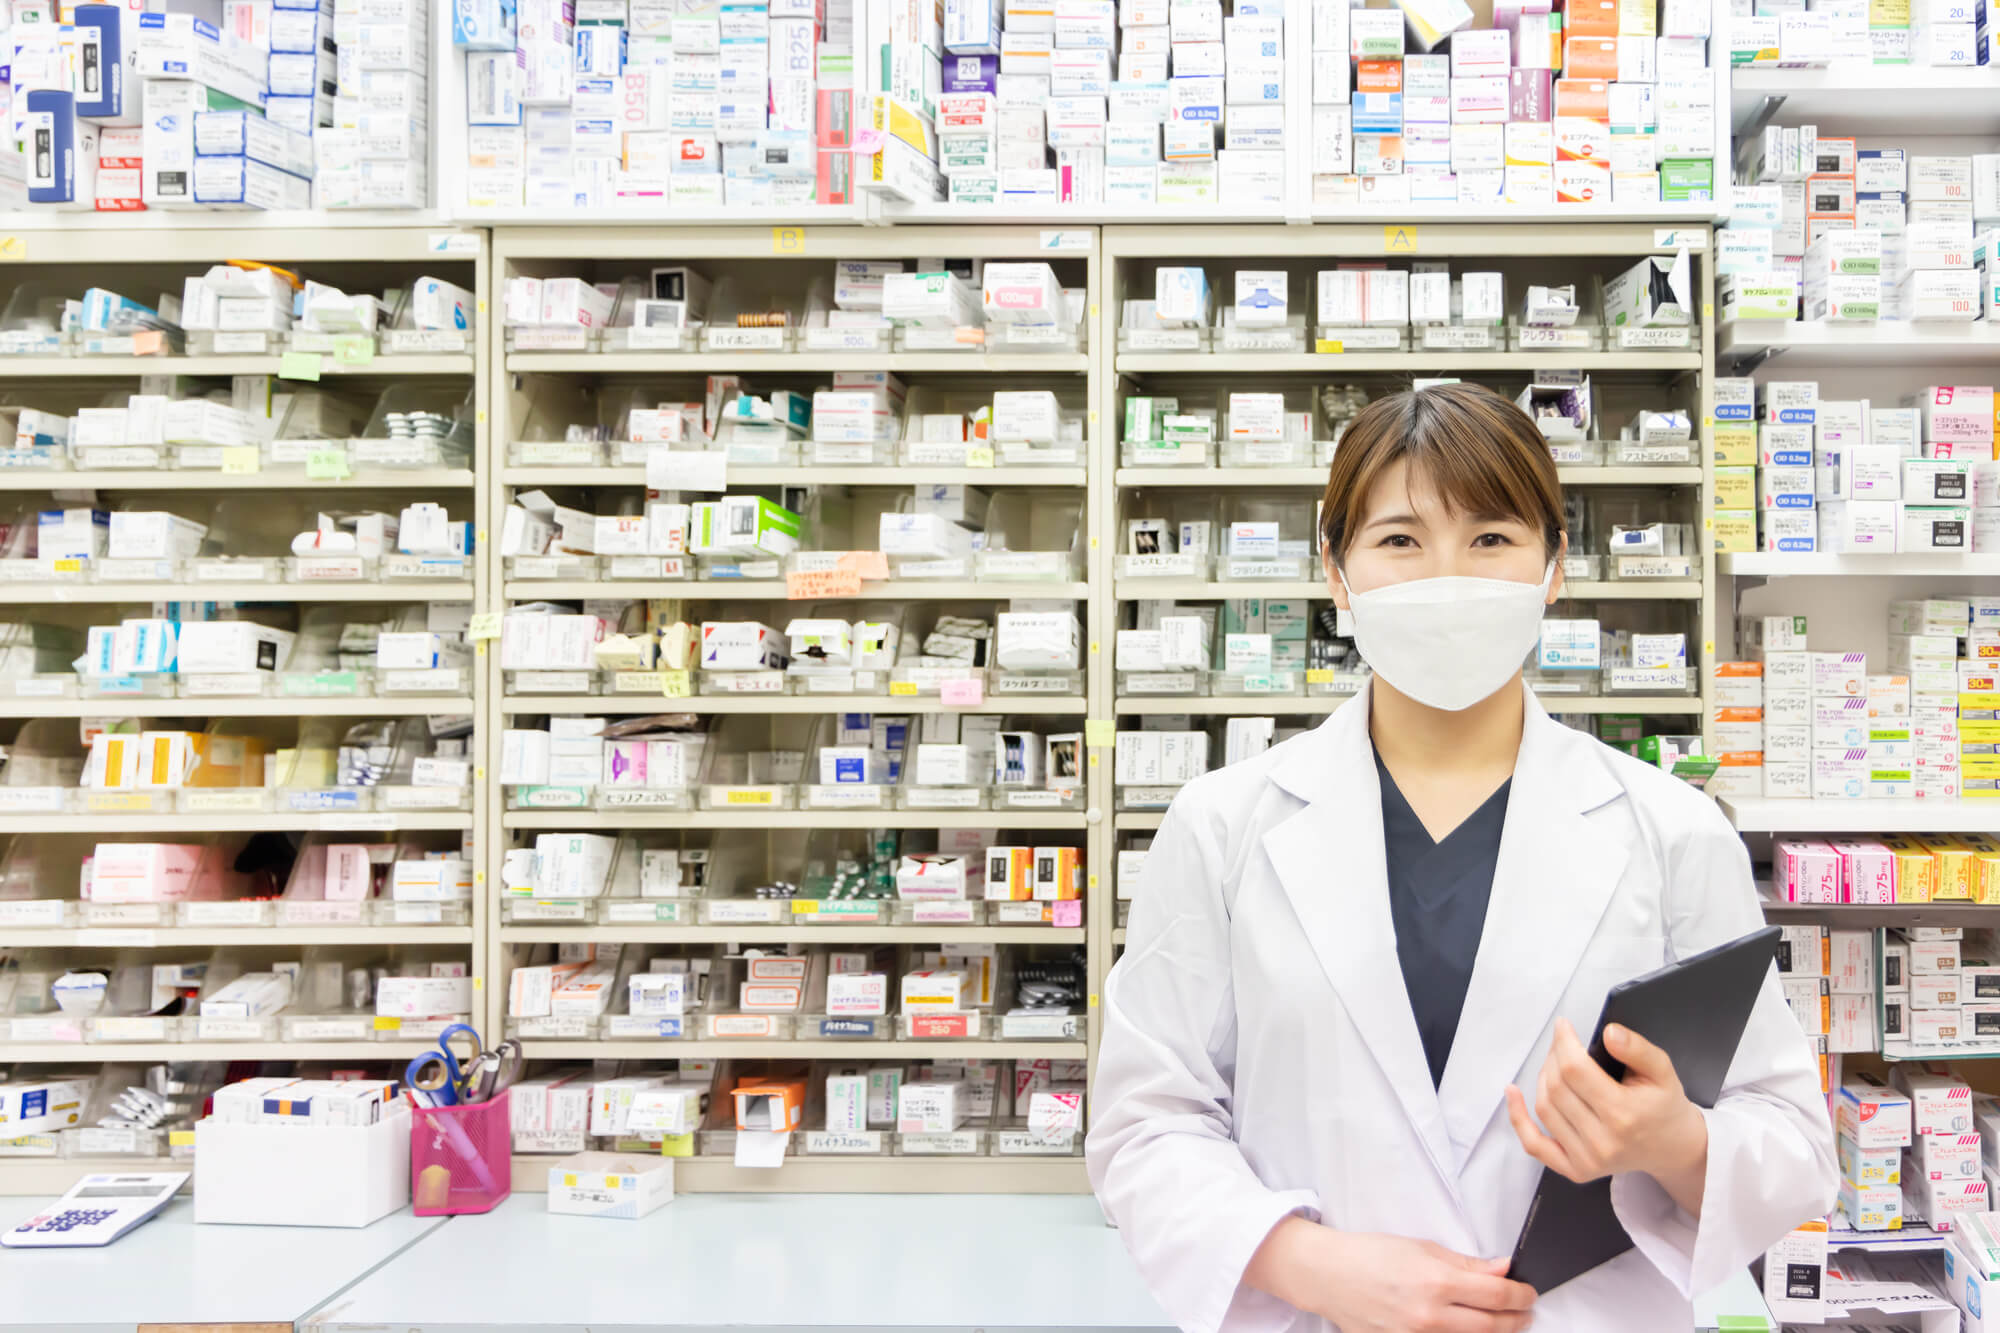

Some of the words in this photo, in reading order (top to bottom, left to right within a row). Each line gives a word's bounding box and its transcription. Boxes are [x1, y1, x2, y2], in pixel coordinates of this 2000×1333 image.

[790, 25, 810, 71] B25
[961, 63, 977, 75] 20
[624, 73, 645, 121] B50
[781, 230, 797, 249] B
[1393, 230, 1410, 247] A
